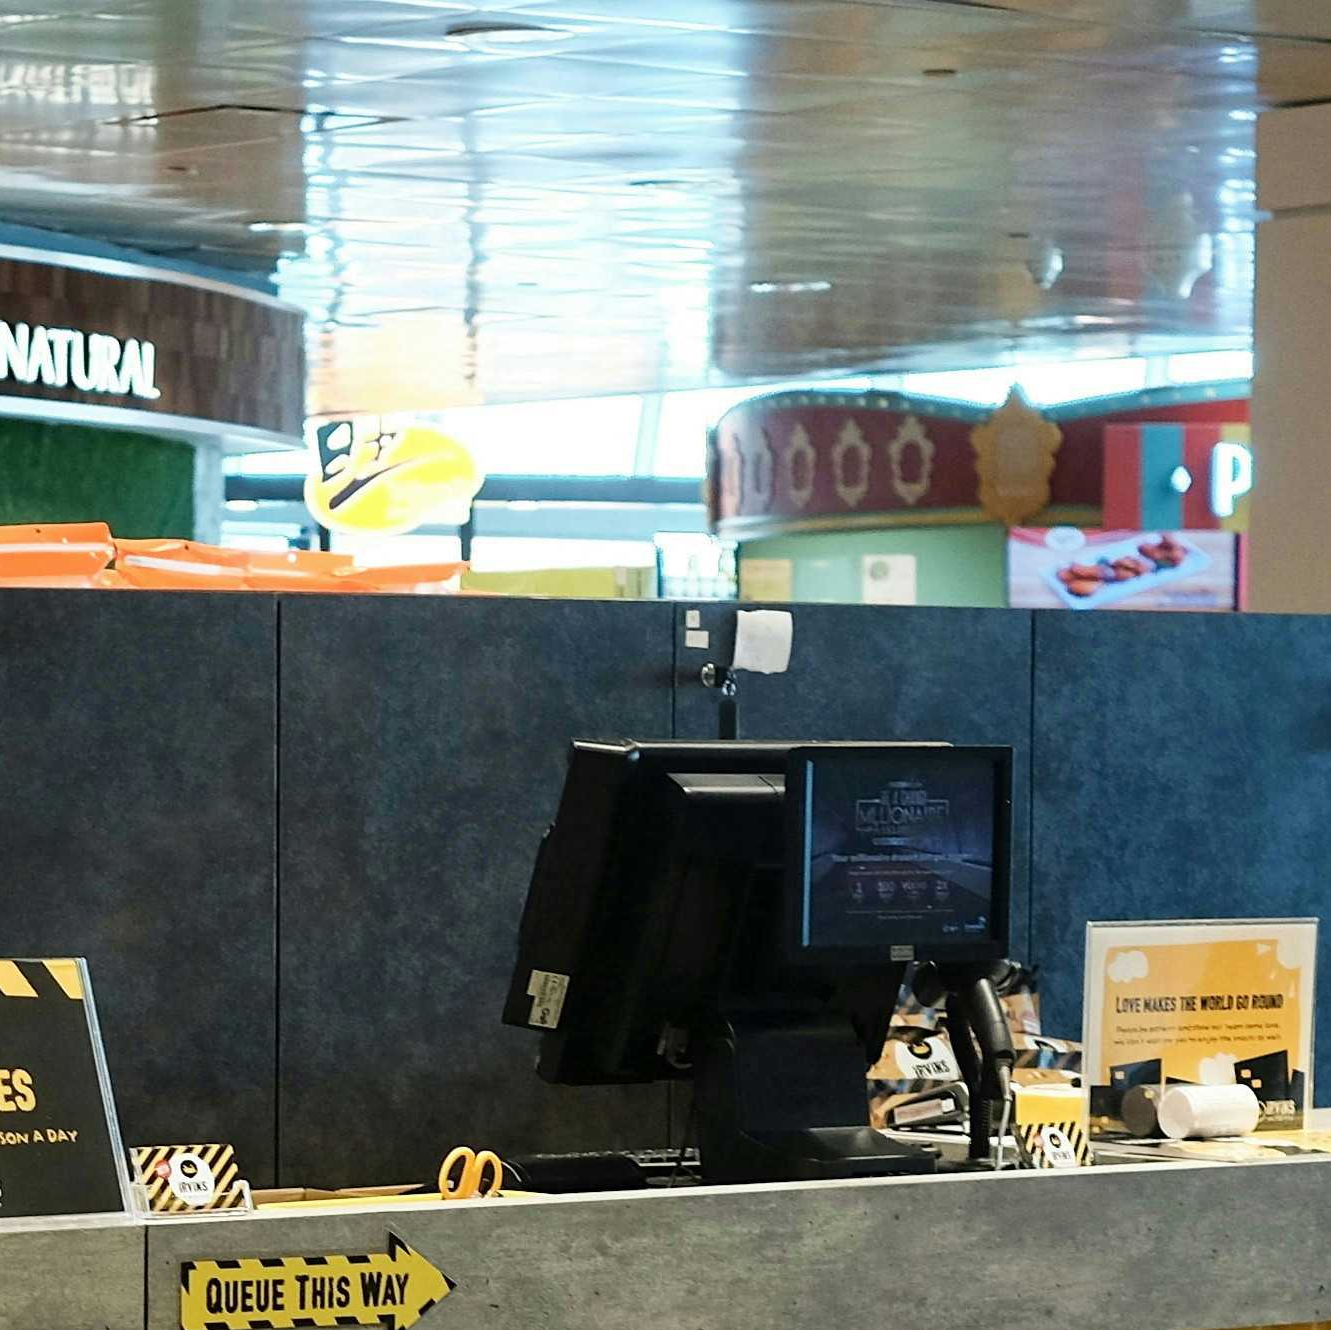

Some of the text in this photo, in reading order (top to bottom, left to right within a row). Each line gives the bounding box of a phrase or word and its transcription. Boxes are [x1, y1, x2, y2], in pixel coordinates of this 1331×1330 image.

[1116, 994, 1284, 1013] LOVE MAKES THE WORLD GO ROUND
[33, 1129, 45, 1142] A
[47, 1128, 79, 1143] DAY
[206, 1271, 410, 1314] QUEUE THIS WAY
